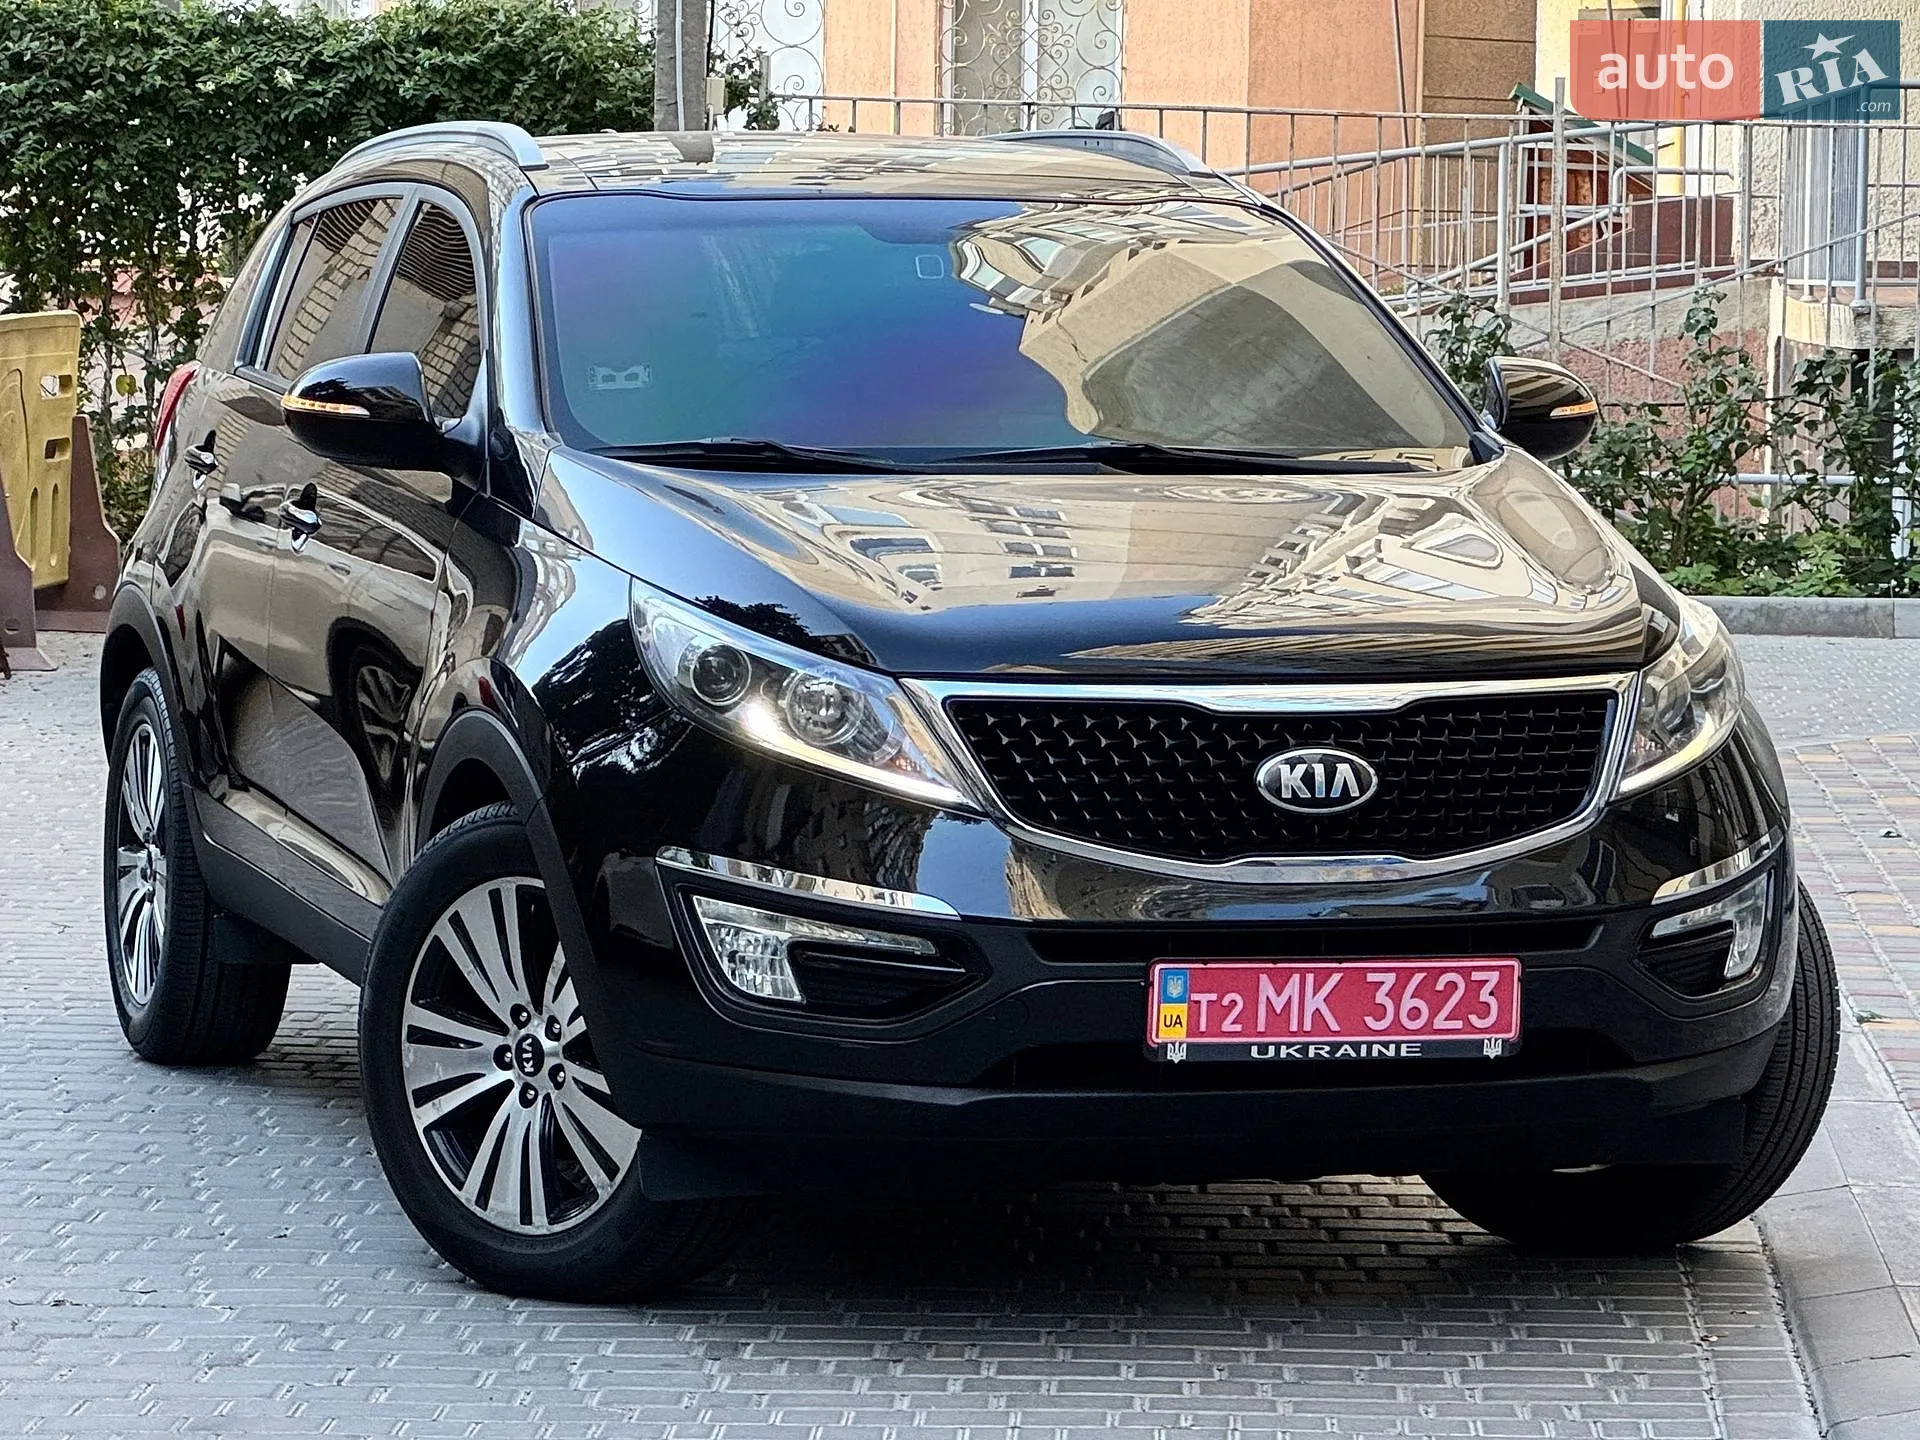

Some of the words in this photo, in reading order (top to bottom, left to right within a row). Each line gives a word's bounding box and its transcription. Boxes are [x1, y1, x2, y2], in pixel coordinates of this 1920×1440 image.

[1278, 763, 1360, 799] KIA
[1363, 971, 1501, 1032] 3623
[1163, 1014, 1183, 1028] UA
[522, 1038, 535, 1073] KIA
[1250, 1043, 1422, 1060] UKRAINE
